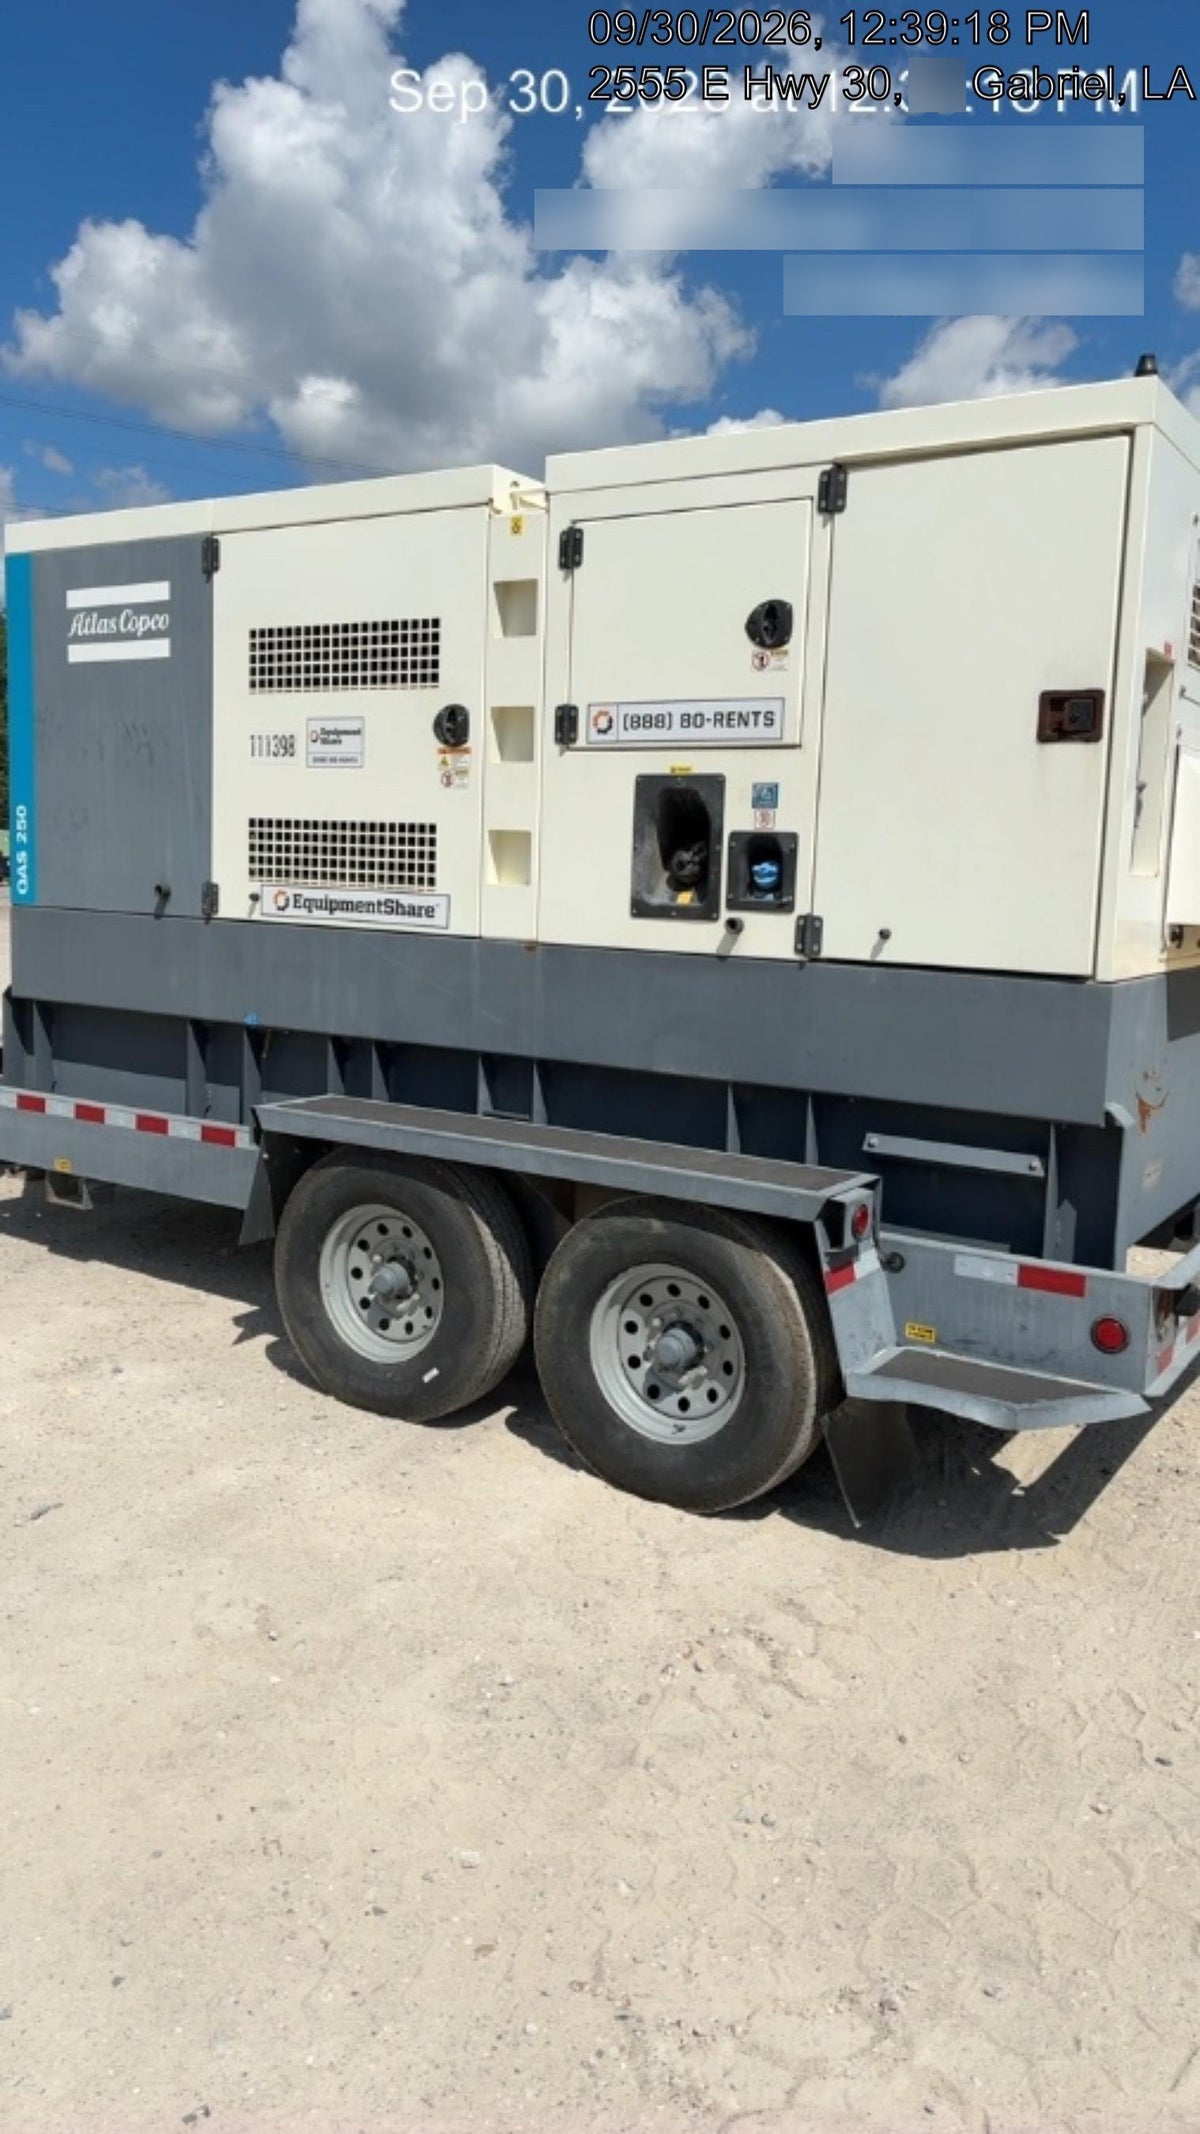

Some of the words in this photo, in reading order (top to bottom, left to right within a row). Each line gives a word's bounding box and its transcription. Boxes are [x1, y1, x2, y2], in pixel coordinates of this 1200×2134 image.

[67, 611, 117, 638] Atlas
[119, 608, 170, 637] Copco
[622, 711, 673, 732] (888)
[249, 734, 296, 757] 111398
[15, 804, 27, 845] 250
[292, 893, 437, 919] EquipmentShare
